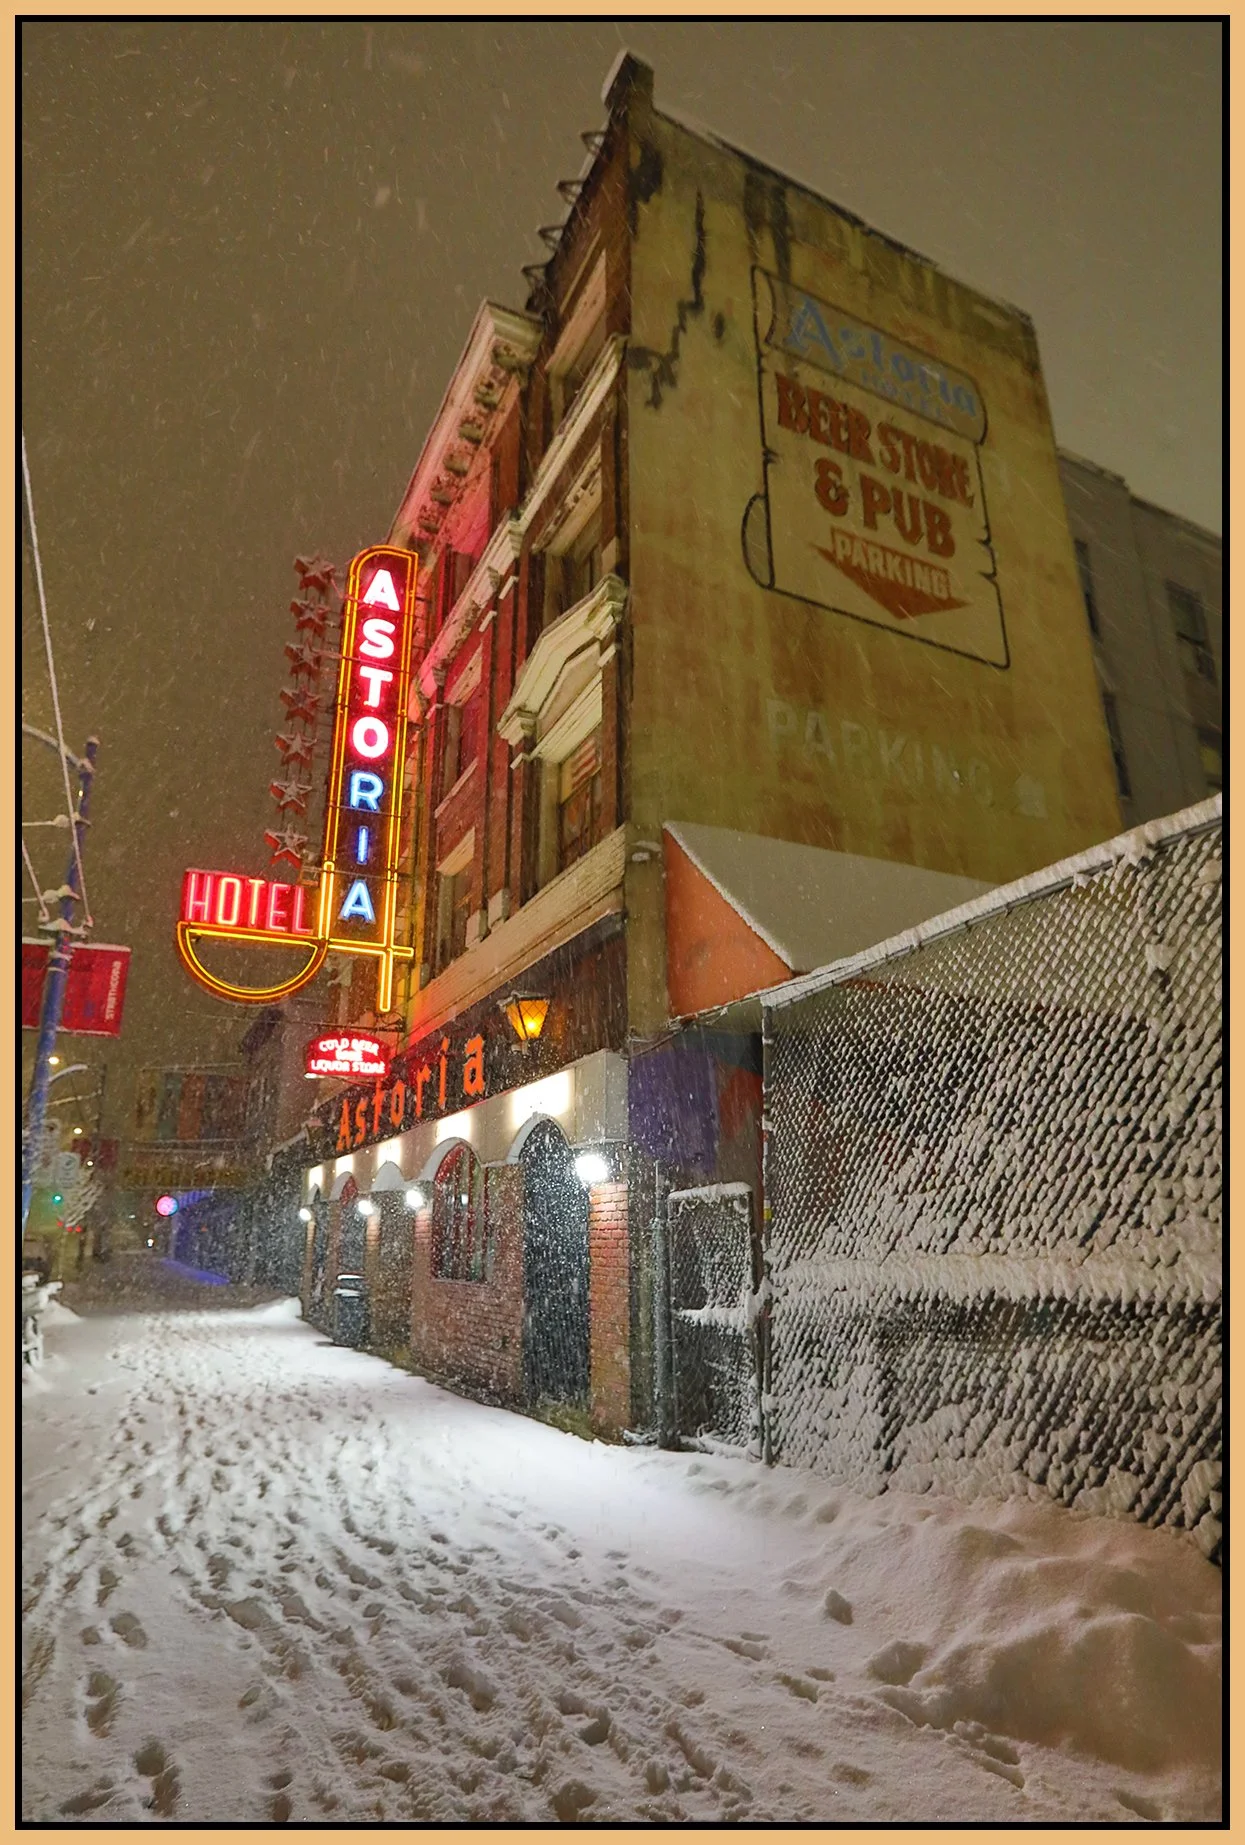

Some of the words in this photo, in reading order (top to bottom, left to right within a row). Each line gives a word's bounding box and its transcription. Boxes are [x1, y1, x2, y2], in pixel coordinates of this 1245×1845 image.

[776, 372, 876, 466] BEER
[877, 422, 975, 508] STORE
[814, 457, 849, 517] &
[859, 473, 955, 560] PUB
[835, 535, 949, 600] PARKING
[339, 569, 400, 924] ASTORIA
[186, 873, 313, 935] HOTEL
[311, 1059, 350, 1072] LIQUOR
[351, 1060, 385, 1074] STORE
[319, 1038, 350, 1052] COLD
